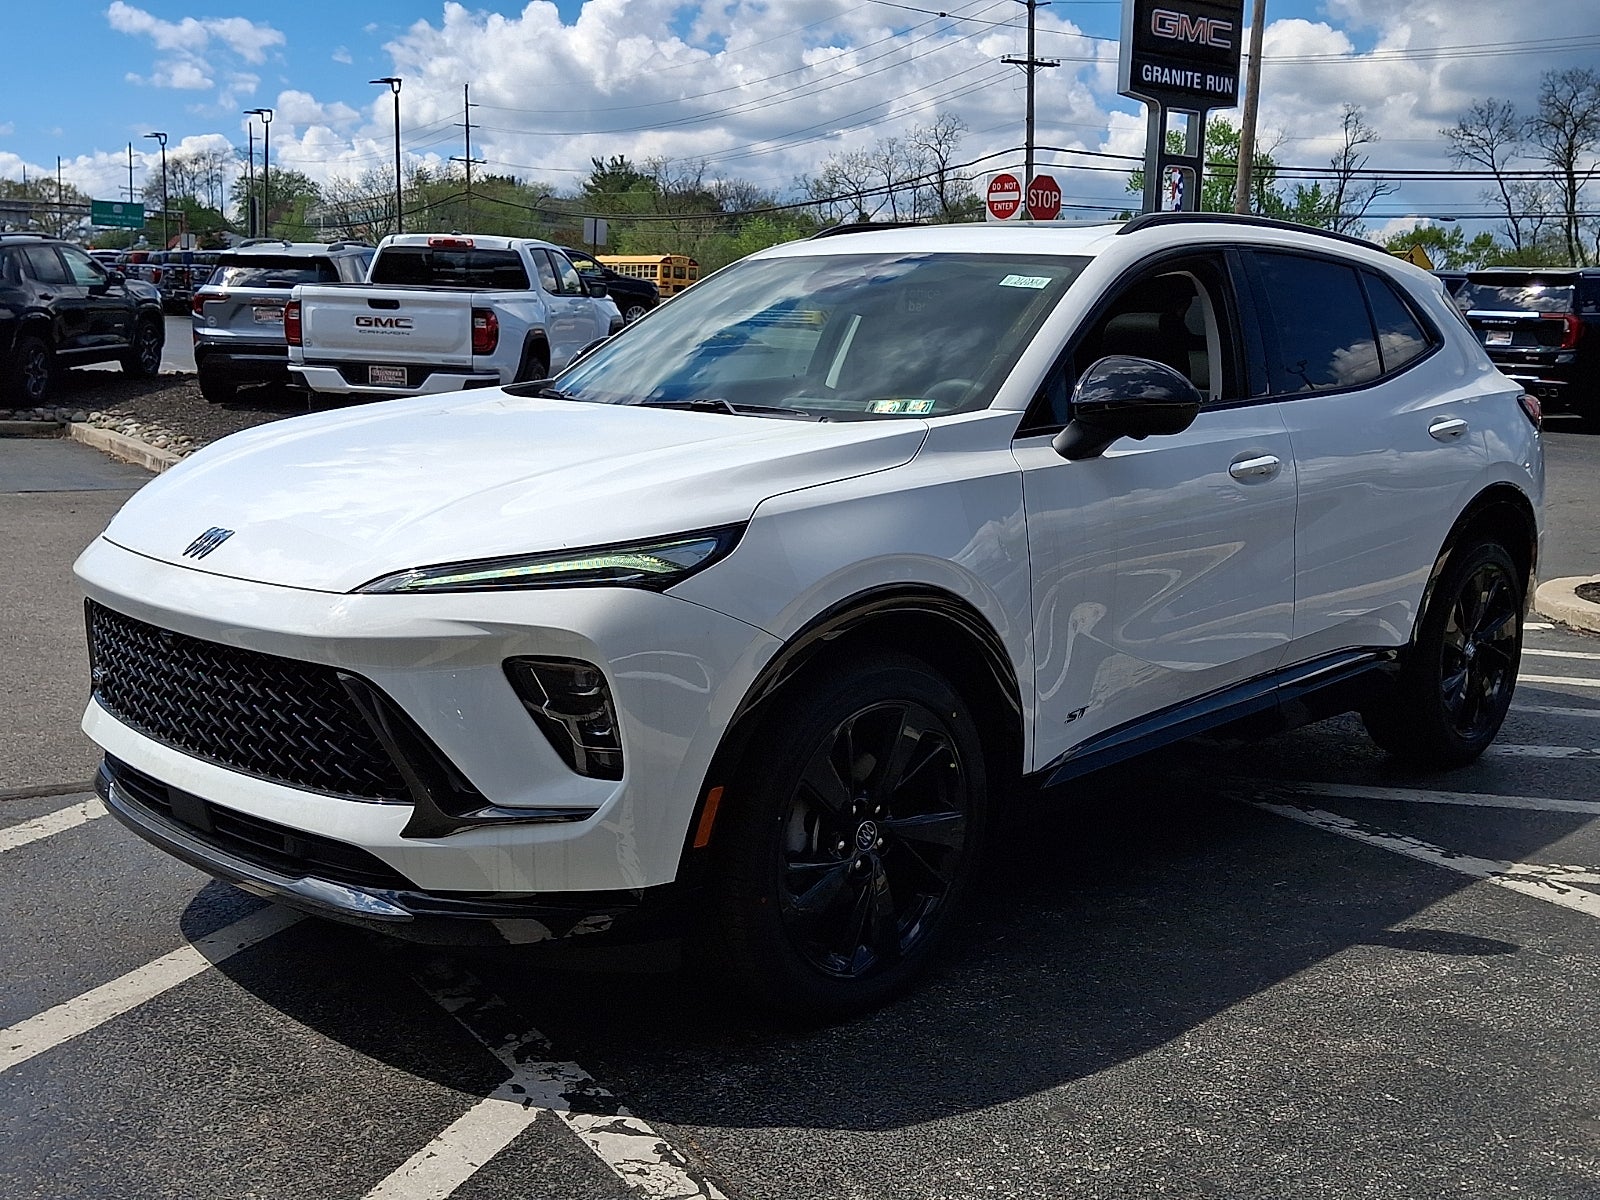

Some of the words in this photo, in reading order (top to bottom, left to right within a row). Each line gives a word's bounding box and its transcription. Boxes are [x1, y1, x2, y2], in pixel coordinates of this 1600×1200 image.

[1151, 8, 1233, 49] GMC
[1142, 64, 1202, 89] GRANITE
[1206, 74, 1234, 94] RUN
[992, 182, 1001, 191] DO
[1004, 181, 1017, 190] NOT
[993, 202, 1013, 211] ENTER
[1029, 188, 1059, 208] STOP
[355, 316, 414, 329] GMC
[1064, 705, 1090, 724] ST
